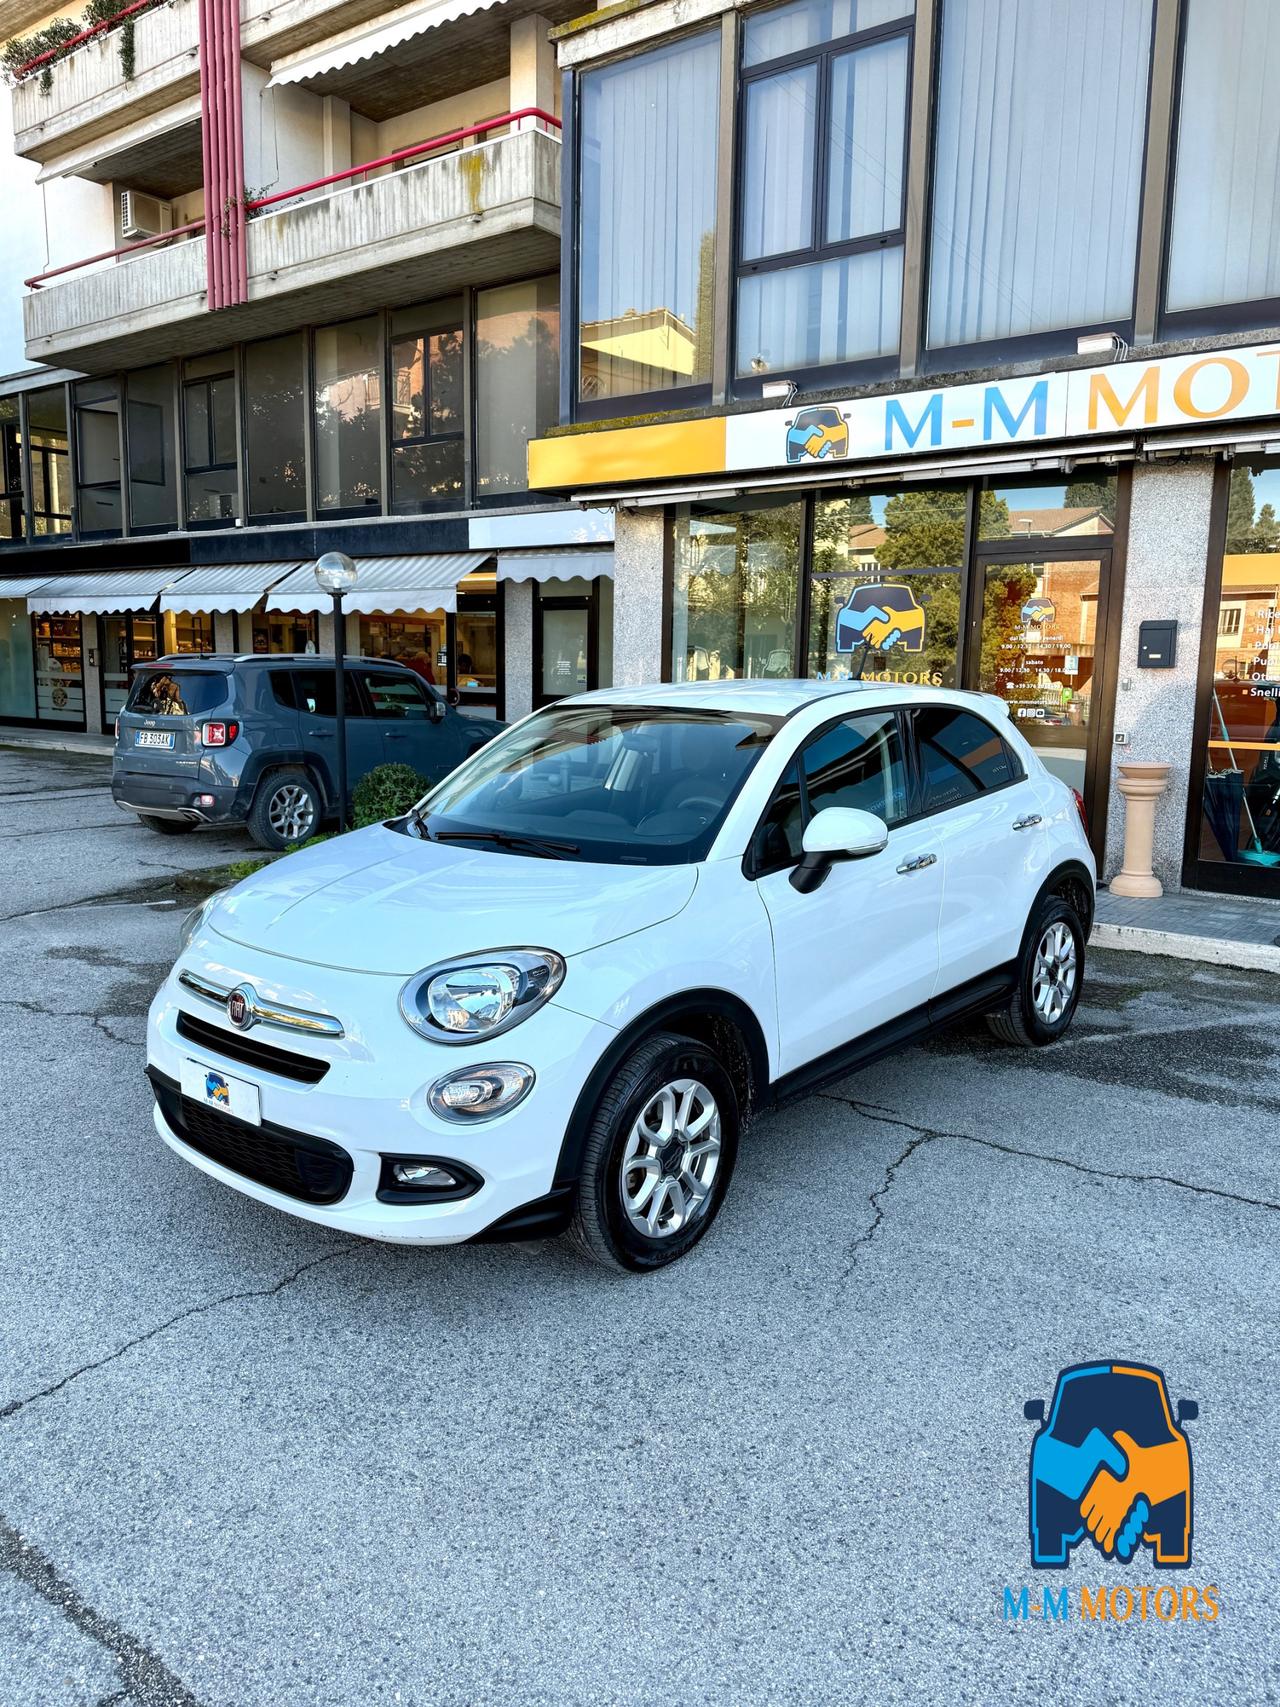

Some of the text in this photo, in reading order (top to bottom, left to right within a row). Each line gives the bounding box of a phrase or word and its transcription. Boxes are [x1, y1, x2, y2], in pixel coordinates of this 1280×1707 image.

[884, 380, 1049, 451] M-M
[816, 670, 943, 686] MM MOTORS
[231, 1000, 244, 1018] FIAT
